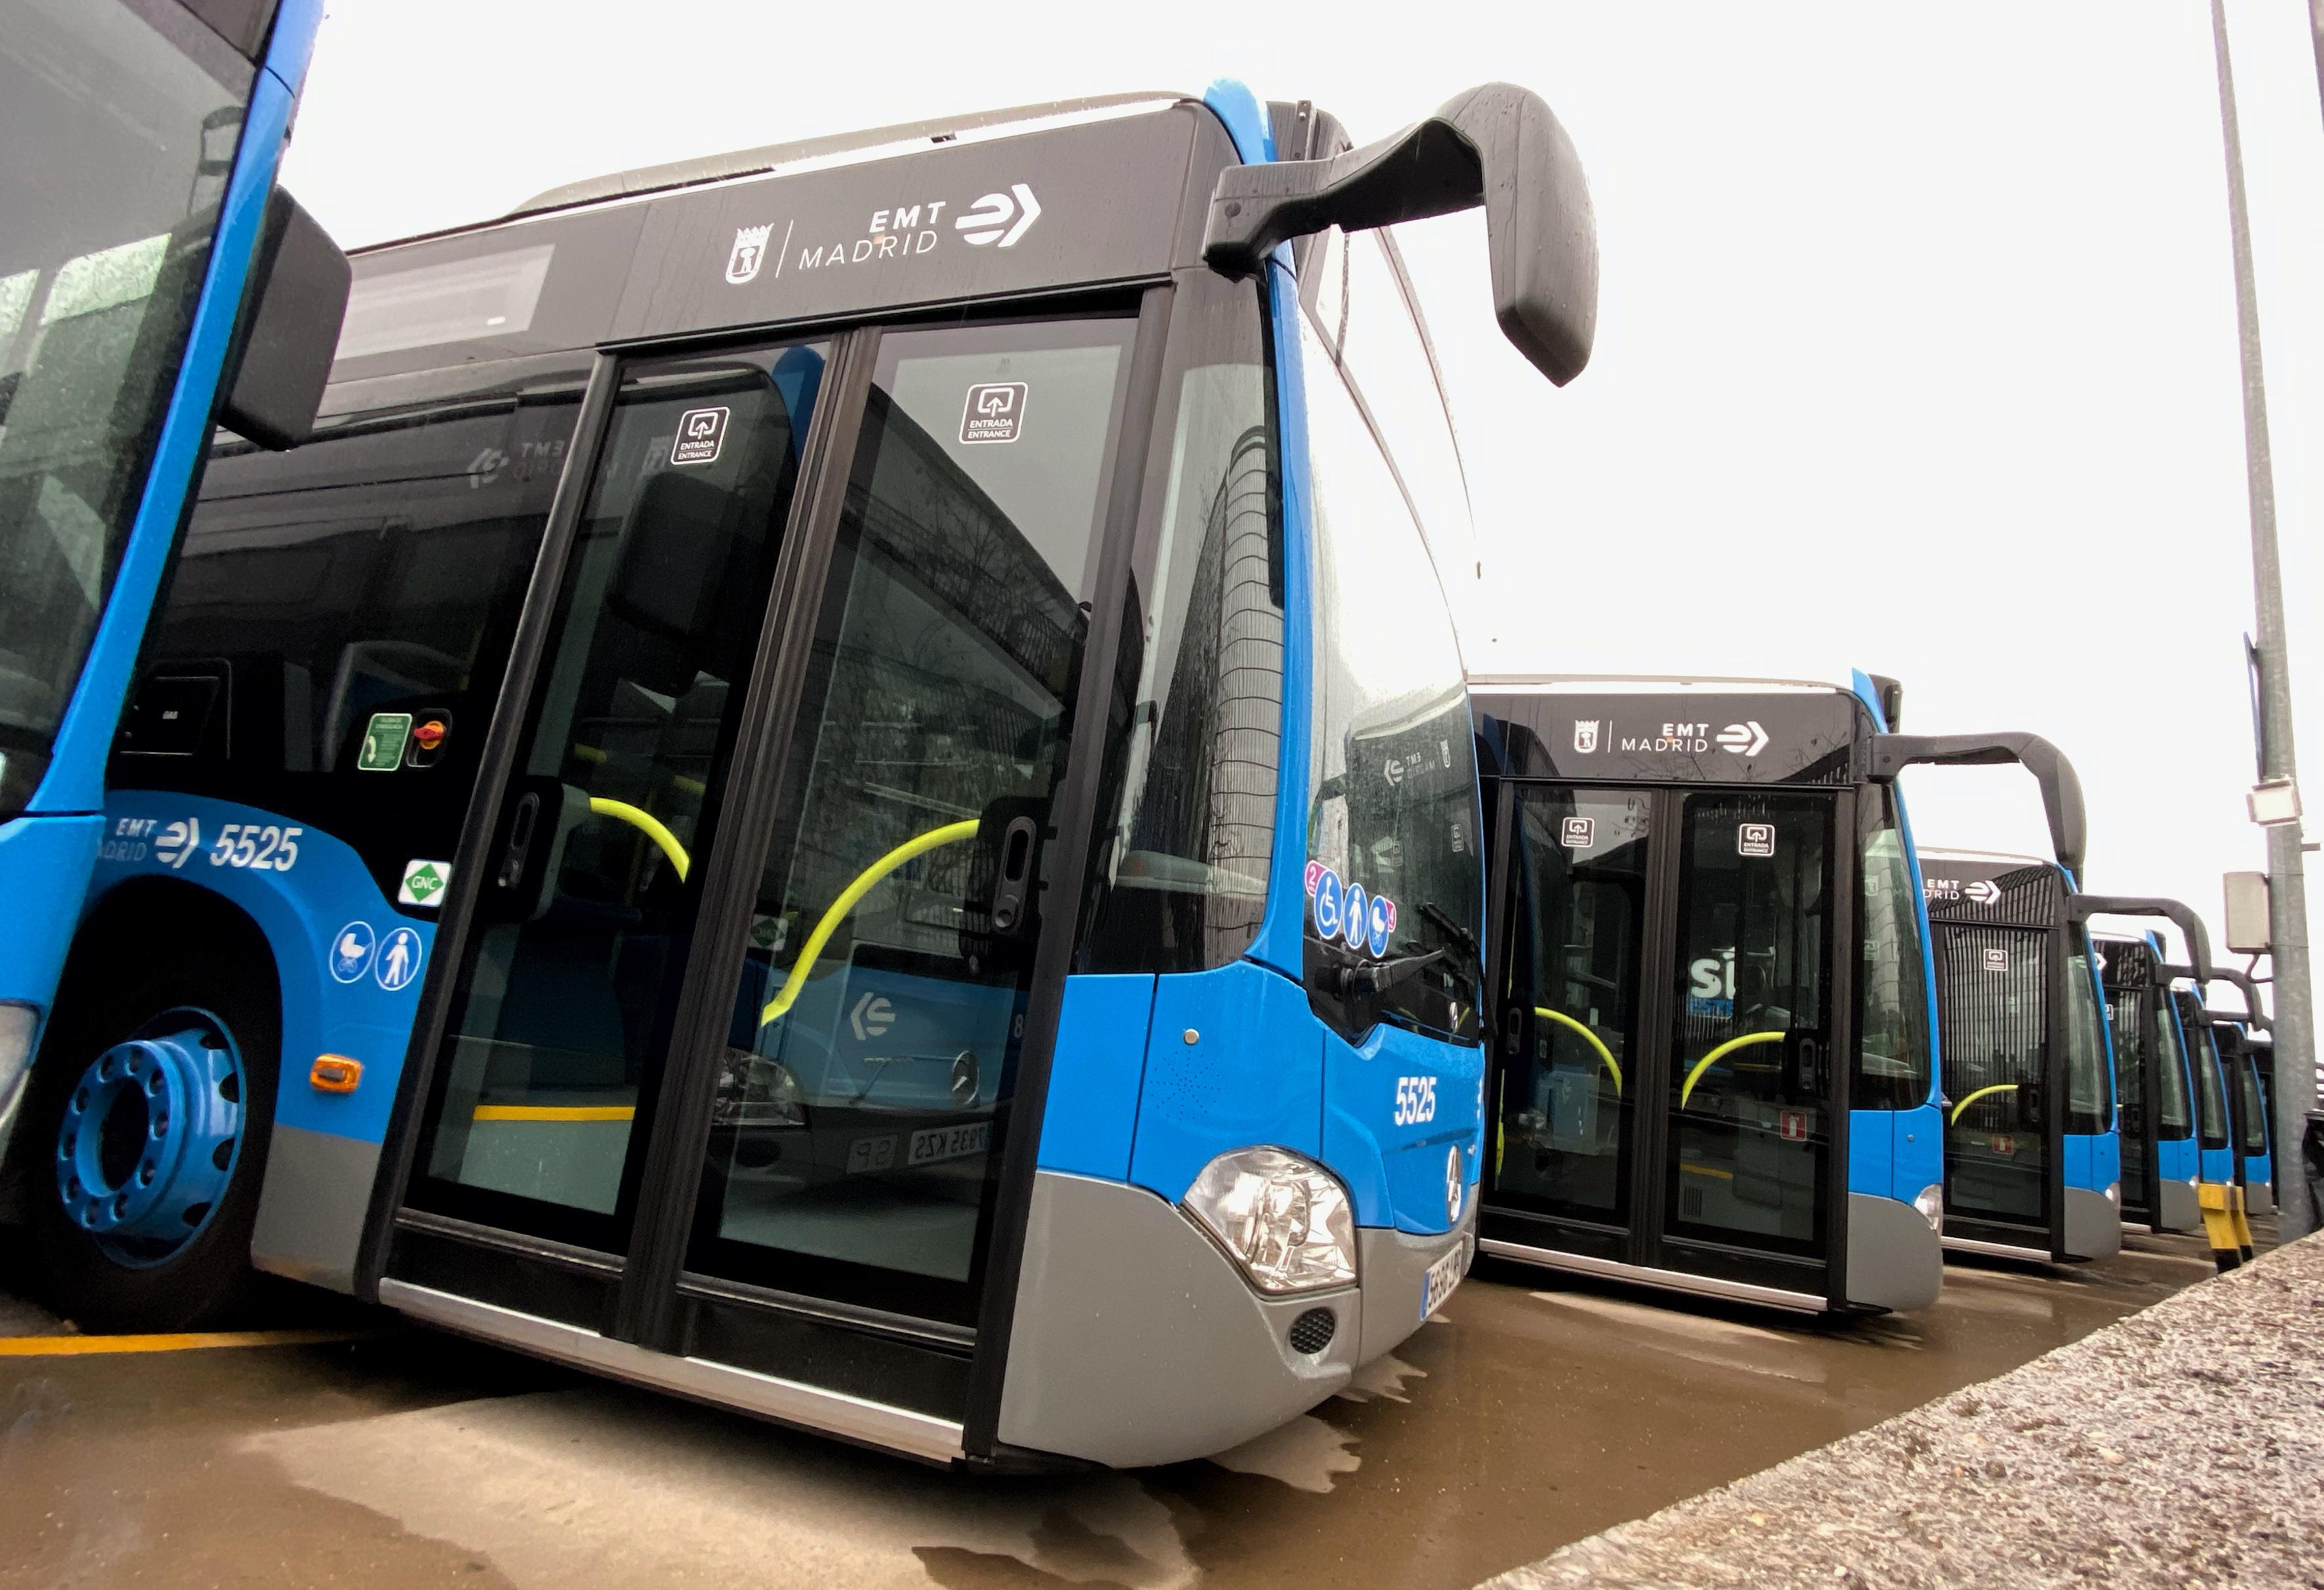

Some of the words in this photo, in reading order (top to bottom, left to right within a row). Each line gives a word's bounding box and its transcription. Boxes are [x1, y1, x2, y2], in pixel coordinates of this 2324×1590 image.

[870, 201, 946, 233] EMT
[798, 230, 938, 270] MADRID
[969, 419, 1013, 429] ENTRADA
[967, 430, 1011, 439] ENTRANCE
[680, 440, 715, 450] ENTRADA
[677, 450, 713, 459] ENTRANCE
[1662, 723, 1709, 736] EMT
[1622, 738, 1708, 752] MADRID
[116, 818, 158, 837] EMT
[98, 840, 148, 862] DRID
[210, 824, 303, 871] 5525
[412, 875, 438, 890] GNC
[1309, 866, 1317, 886] 2
[1927, 879, 1960, 890] EMT
[1923, 889, 1960, 900] DRID
[1393, 1076, 1437, 1127] 5525
